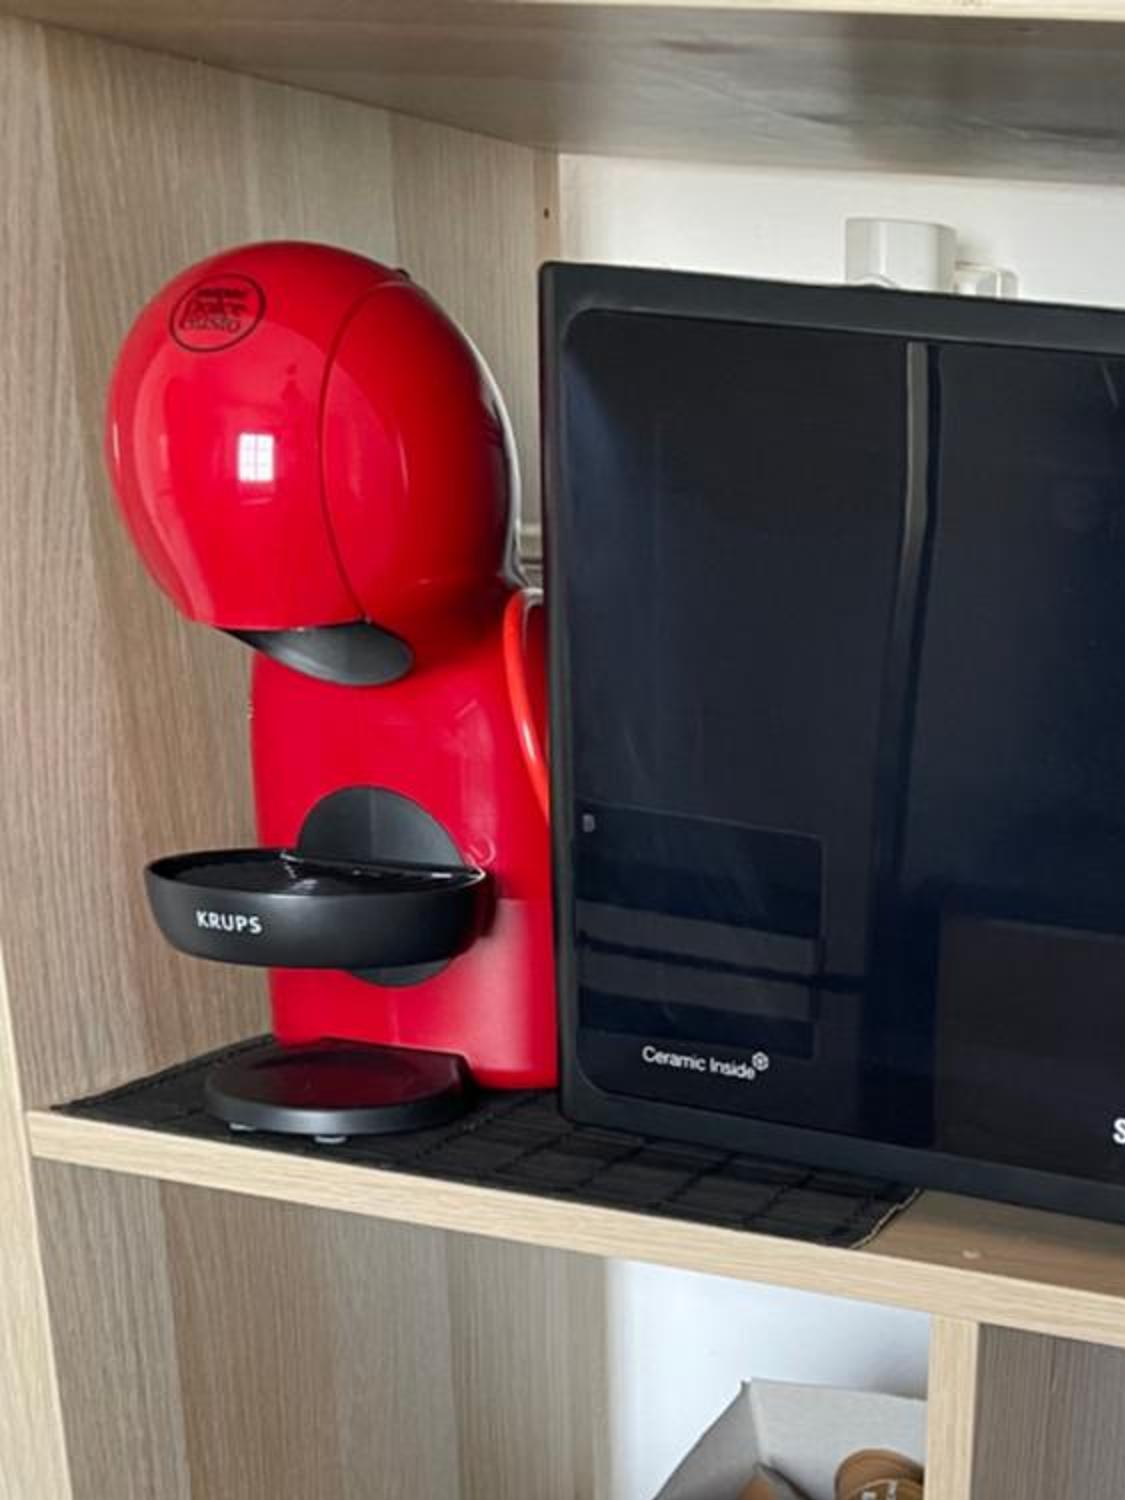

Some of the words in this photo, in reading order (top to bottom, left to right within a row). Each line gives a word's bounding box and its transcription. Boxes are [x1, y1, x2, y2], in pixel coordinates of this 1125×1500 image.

[196, 910, 262, 934] KRUPS
[642, 1045, 706, 1071] Ceramic
[709, 1057, 756, 1081] Inside
